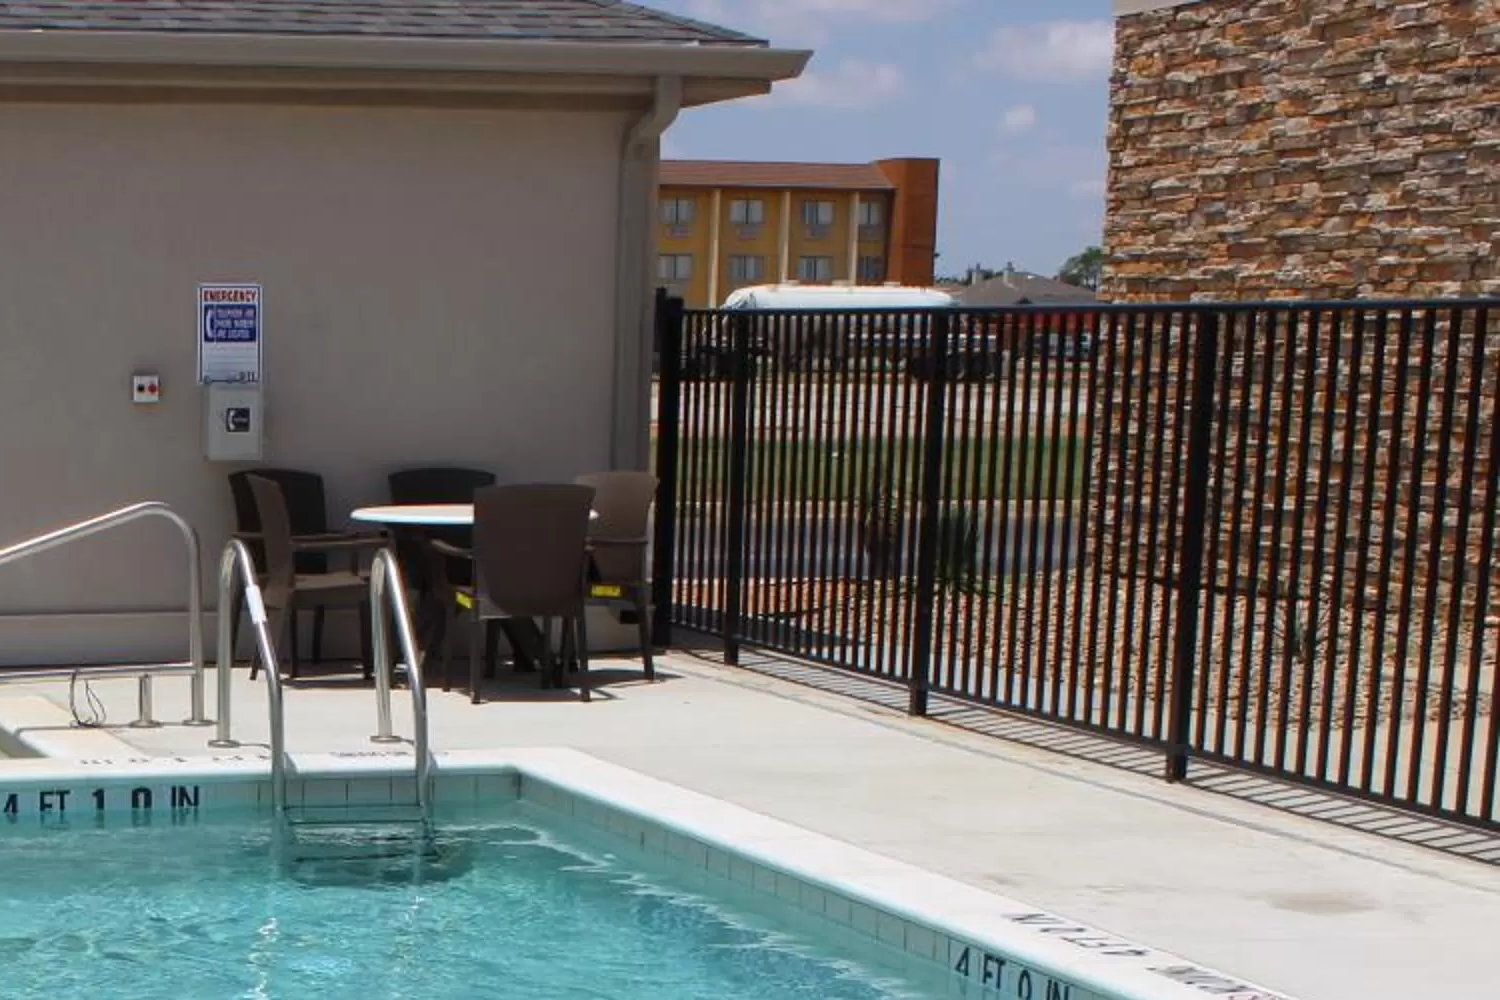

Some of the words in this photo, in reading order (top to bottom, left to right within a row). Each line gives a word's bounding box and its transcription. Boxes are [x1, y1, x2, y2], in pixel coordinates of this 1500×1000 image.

[203, 289, 257, 302] EMERGENCY
[3, 792, 18, 814] 4
[39, 790, 71, 812] FT
[171, 784, 200, 808] IN
[955, 946, 970, 977] 4
[981, 952, 1007, 990] FT
